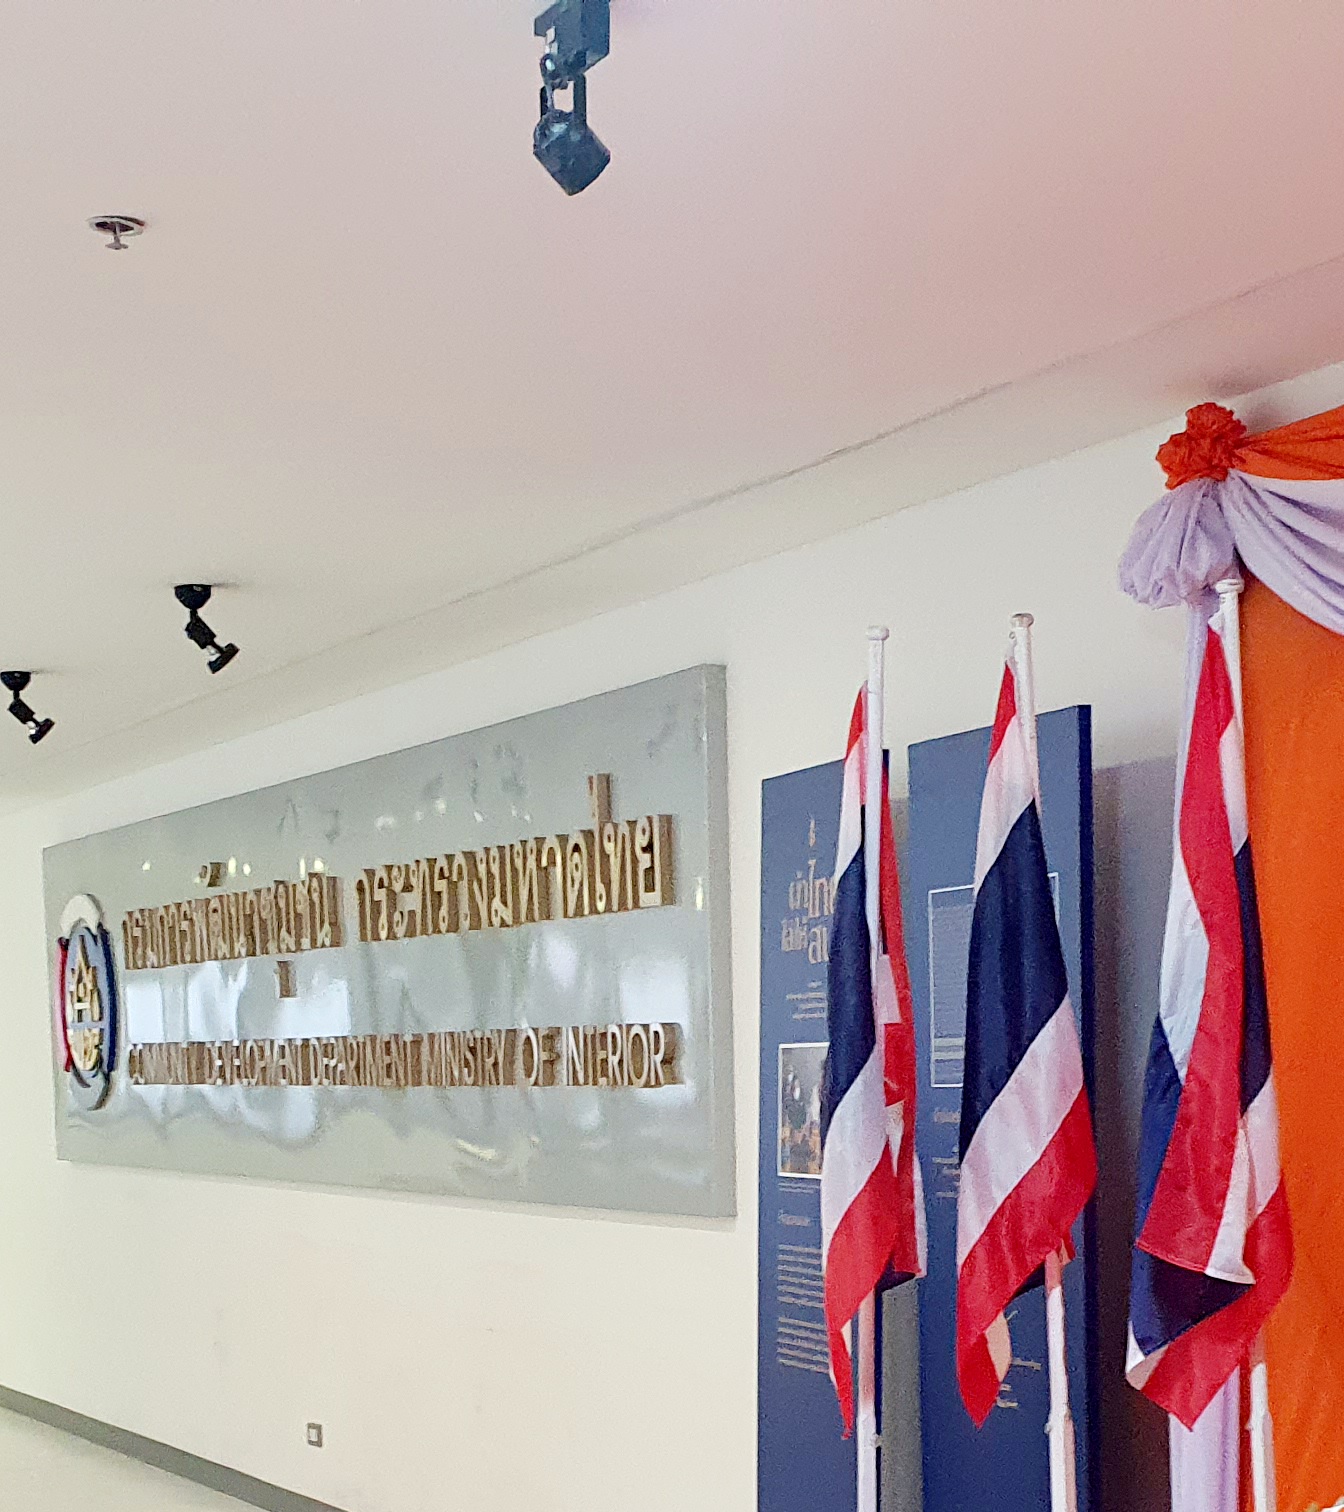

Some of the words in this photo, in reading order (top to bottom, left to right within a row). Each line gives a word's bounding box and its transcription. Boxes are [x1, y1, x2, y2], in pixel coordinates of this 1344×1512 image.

[356, 775, 663, 942] กระทรวงมหาดไทย
[309, 1033, 413, 1086] DEPARTMENT
[421, 1028, 506, 1087] MINISTRY
[515, 1026, 553, 1086] OF
[560, 1022, 666, 1088] INTERIOR
